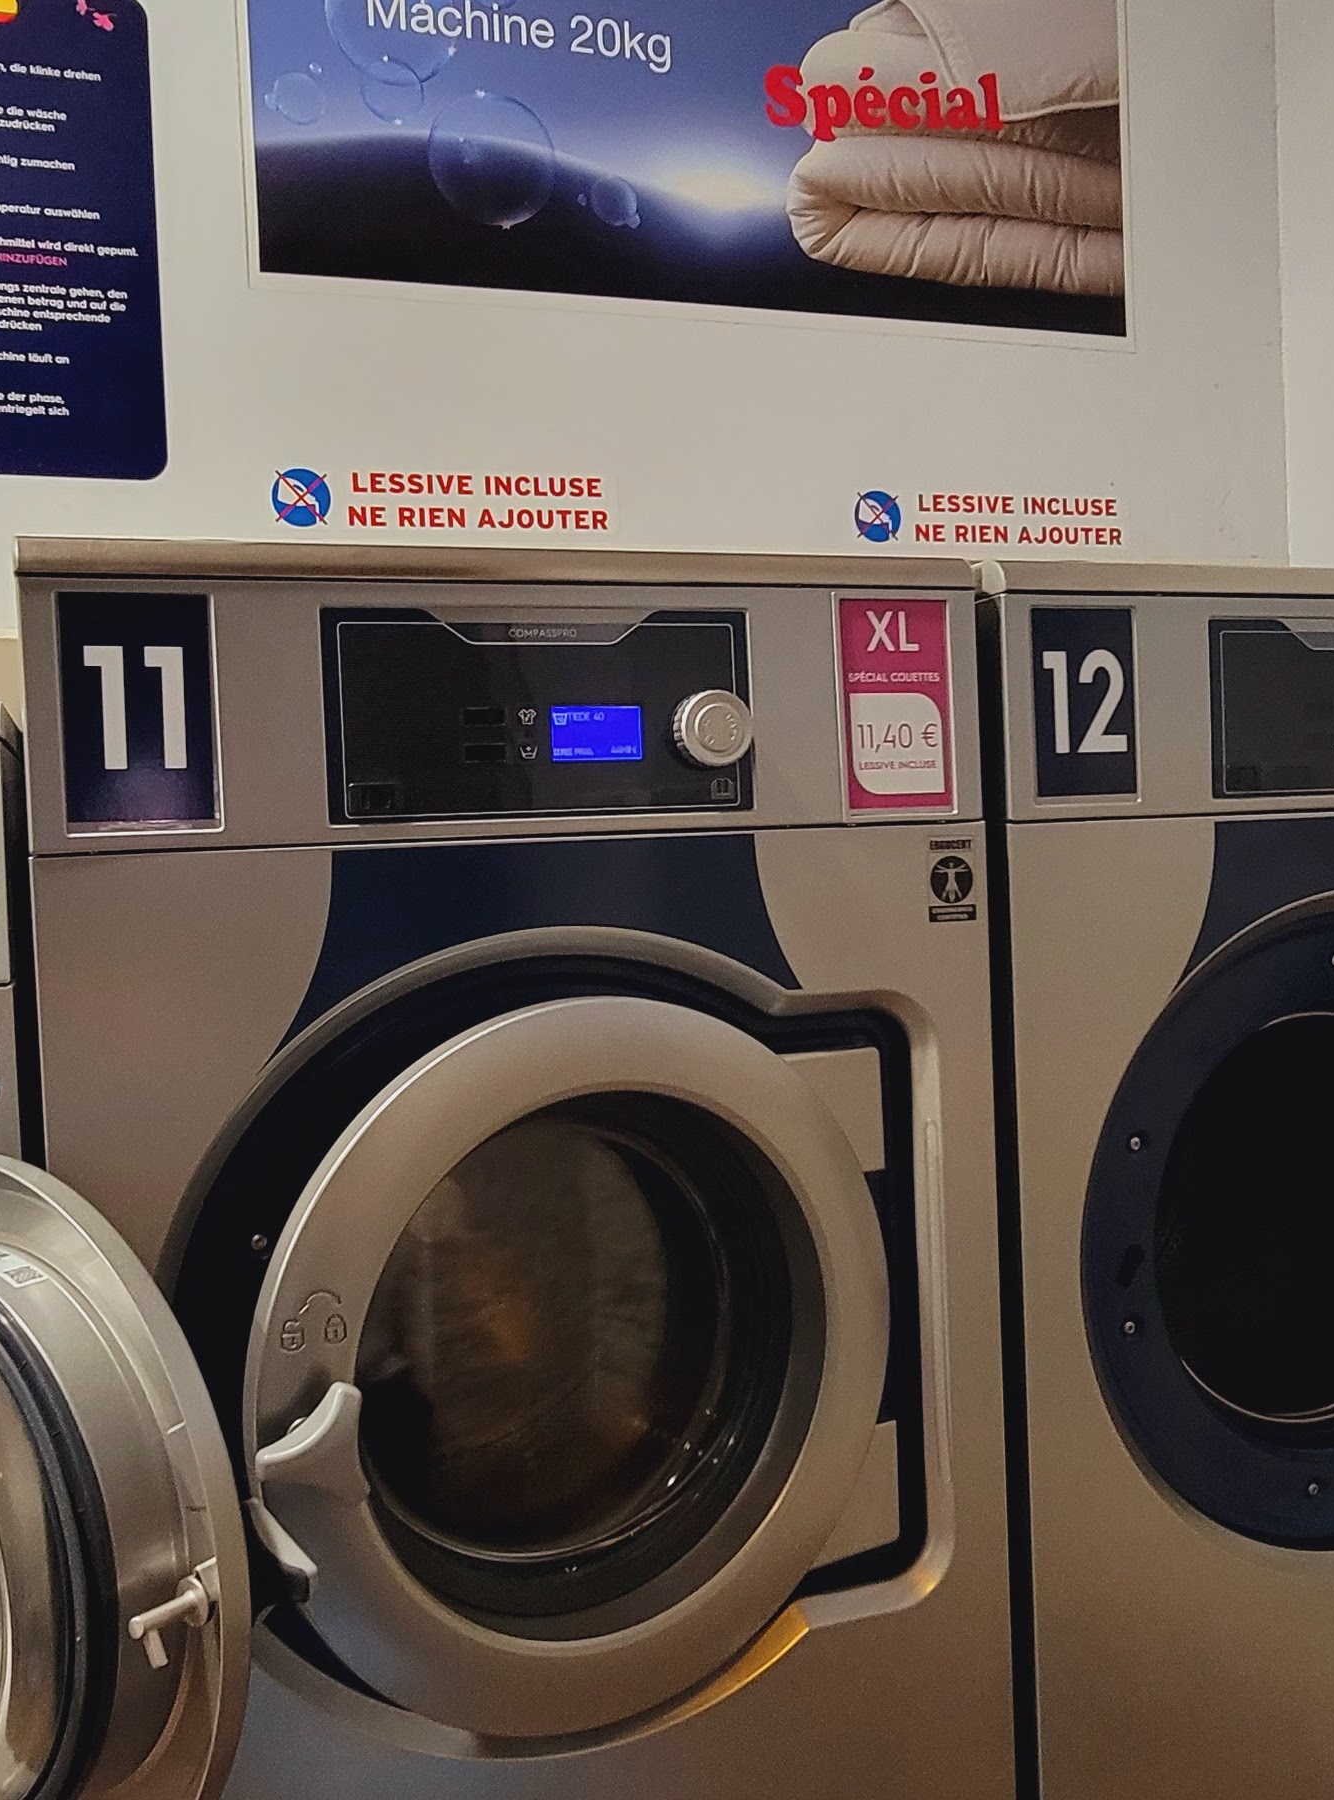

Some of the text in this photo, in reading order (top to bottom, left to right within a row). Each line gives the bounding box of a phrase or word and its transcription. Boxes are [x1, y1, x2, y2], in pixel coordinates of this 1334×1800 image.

[367, 0, 671, 73] Machine 20kg
[5, 105, 24, 117] die
[25, 108, 67, 121] wäsche
[763, 64, 1005, 142] Spécial
[19, 157, 76, 171] zumachen
[42, 207, 101, 220] auswählen
[36, 239, 62, 251] wird
[62, 241, 95, 254] direkt
[26, 352, 53, 364] läuft
[53, 355, 70, 365] an
[6, 391, 27, 402] der
[350, 471, 603, 499] LESSIVE INCLUSE
[919, 492, 1115, 518] LESSIVE INCLUSE
[346, 505, 609, 531] NE RIEN AJOUTER
[914, 522, 1122, 546] NE RIEN AJOUTER
[508, 628, 578, 639] COMPASSPRO
[865, 610, 920, 652] XL
[889, 671, 941, 683] COUETTES
[82, 645, 188, 770] 11
[1042, 649, 1128, 754] 12
[856, 723, 938, 754] 11,40 €
